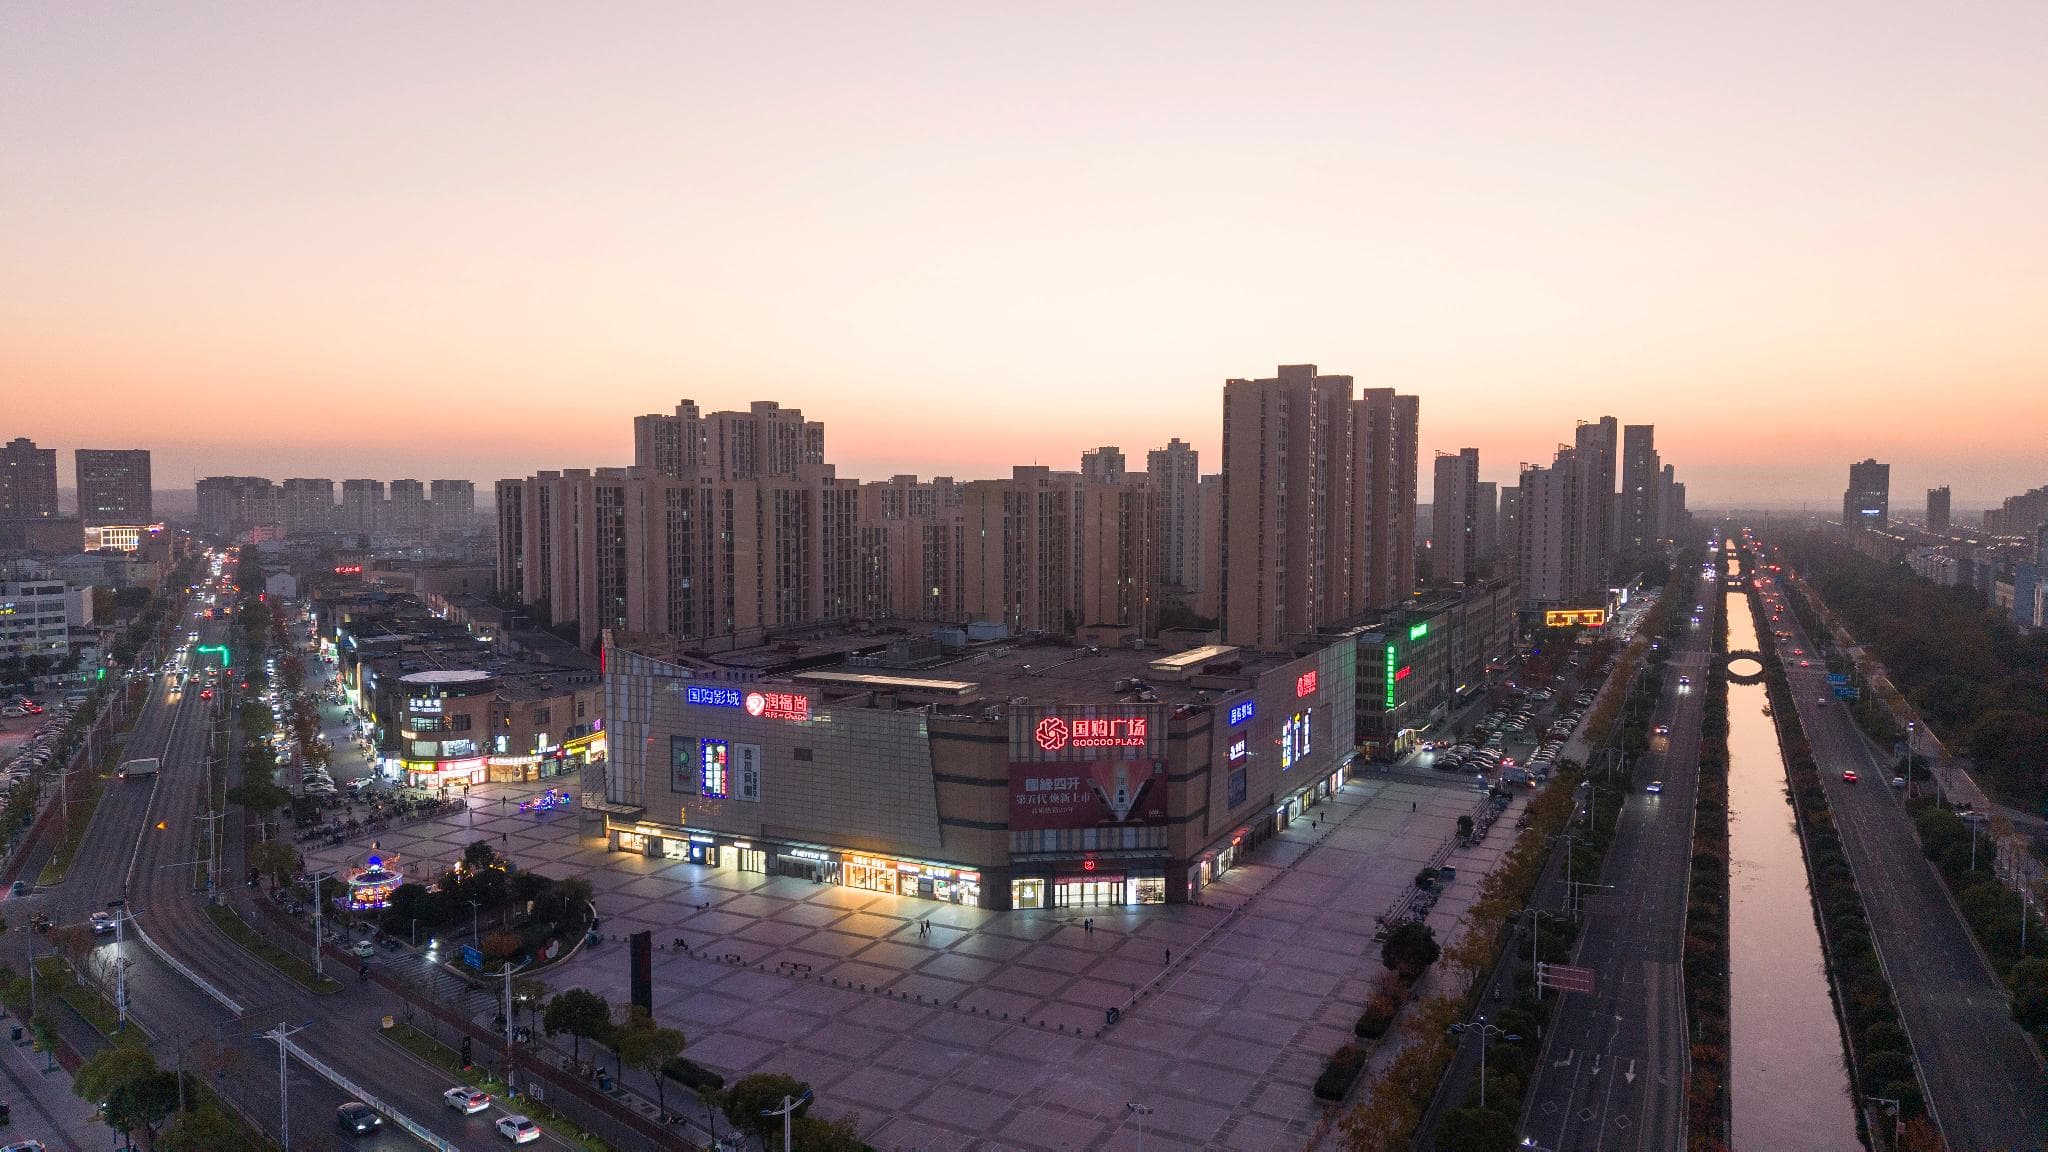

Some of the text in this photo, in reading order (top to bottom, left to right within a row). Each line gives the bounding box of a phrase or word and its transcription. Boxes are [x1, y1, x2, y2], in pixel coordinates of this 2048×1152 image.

[688, 688, 740, 706] 国购影城
[765, 693, 808, 712] 润福尚
[1072, 719, 1145, 737] 国购广场
[1072, 738, 1145, 747] GOOCOO PLAZA
